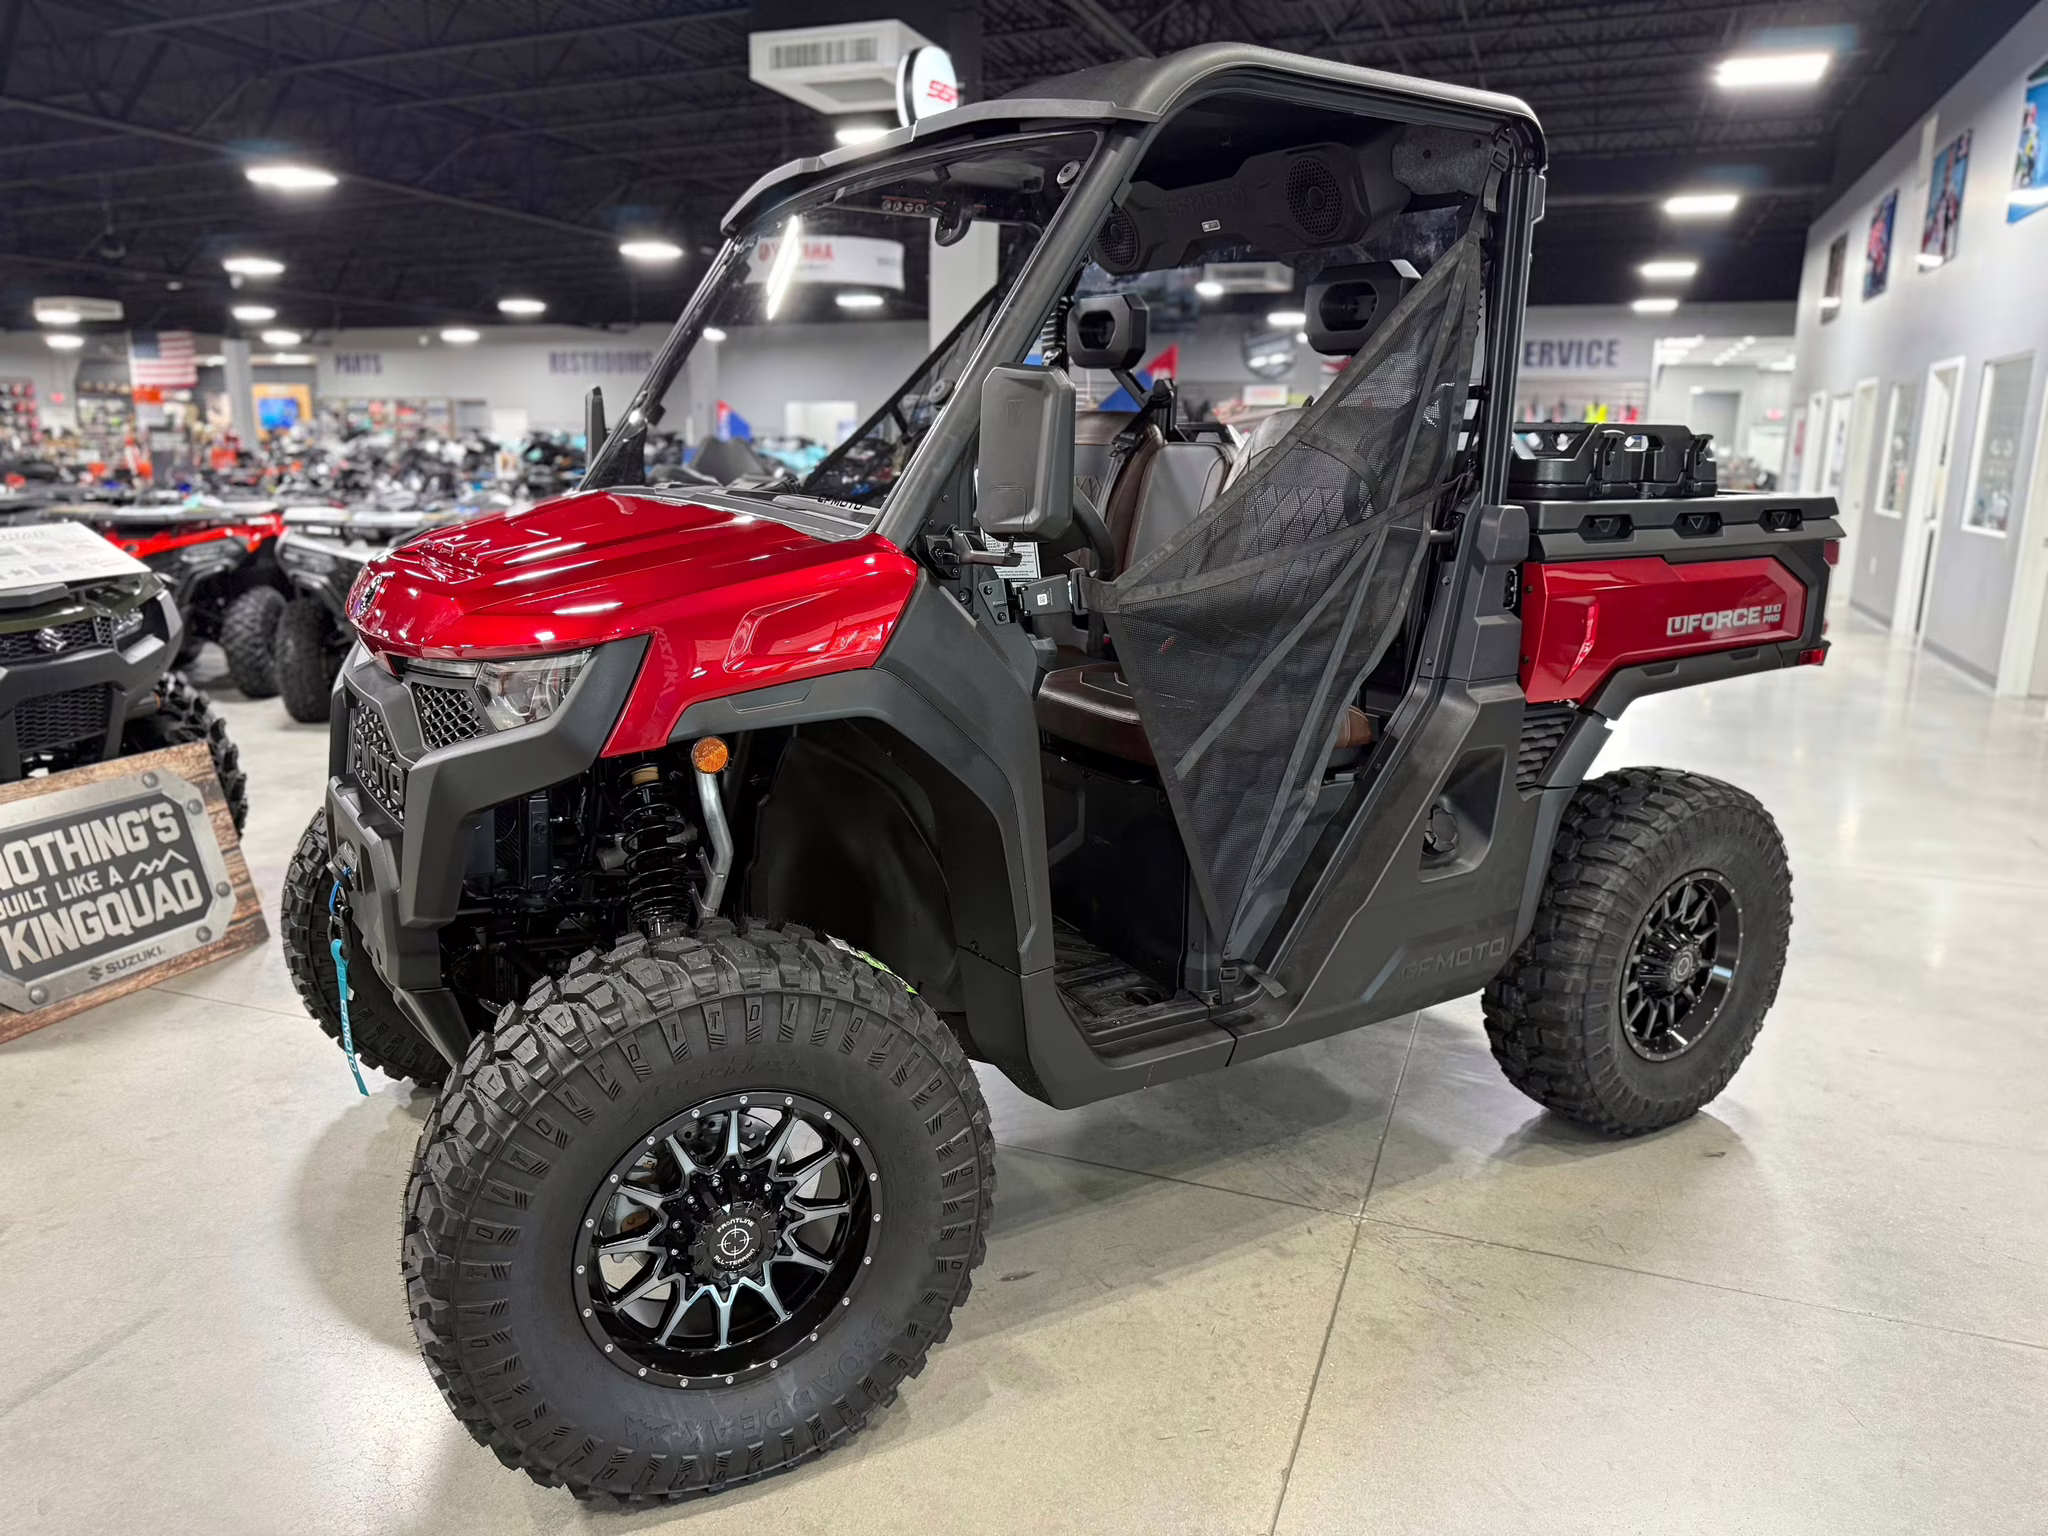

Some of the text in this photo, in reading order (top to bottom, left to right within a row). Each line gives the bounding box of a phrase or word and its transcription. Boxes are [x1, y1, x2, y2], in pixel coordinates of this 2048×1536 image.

[1523, 339, 1620, 369] ERVICE
[1666, 606, 1762, 637] UFORCE
[1763, 613, 1780, 624] PRO
[54, 870, 103, 902] LIKE
[108, 865, 124, 887] A
[0, 868, 203, 971] KINGQUAD
[105, 945, 162, 974] SUZUKI
[716, 1217, 755, 1233] FRONTLINE
[713, 1248, 756, 1266] ALL-TERRAIN
